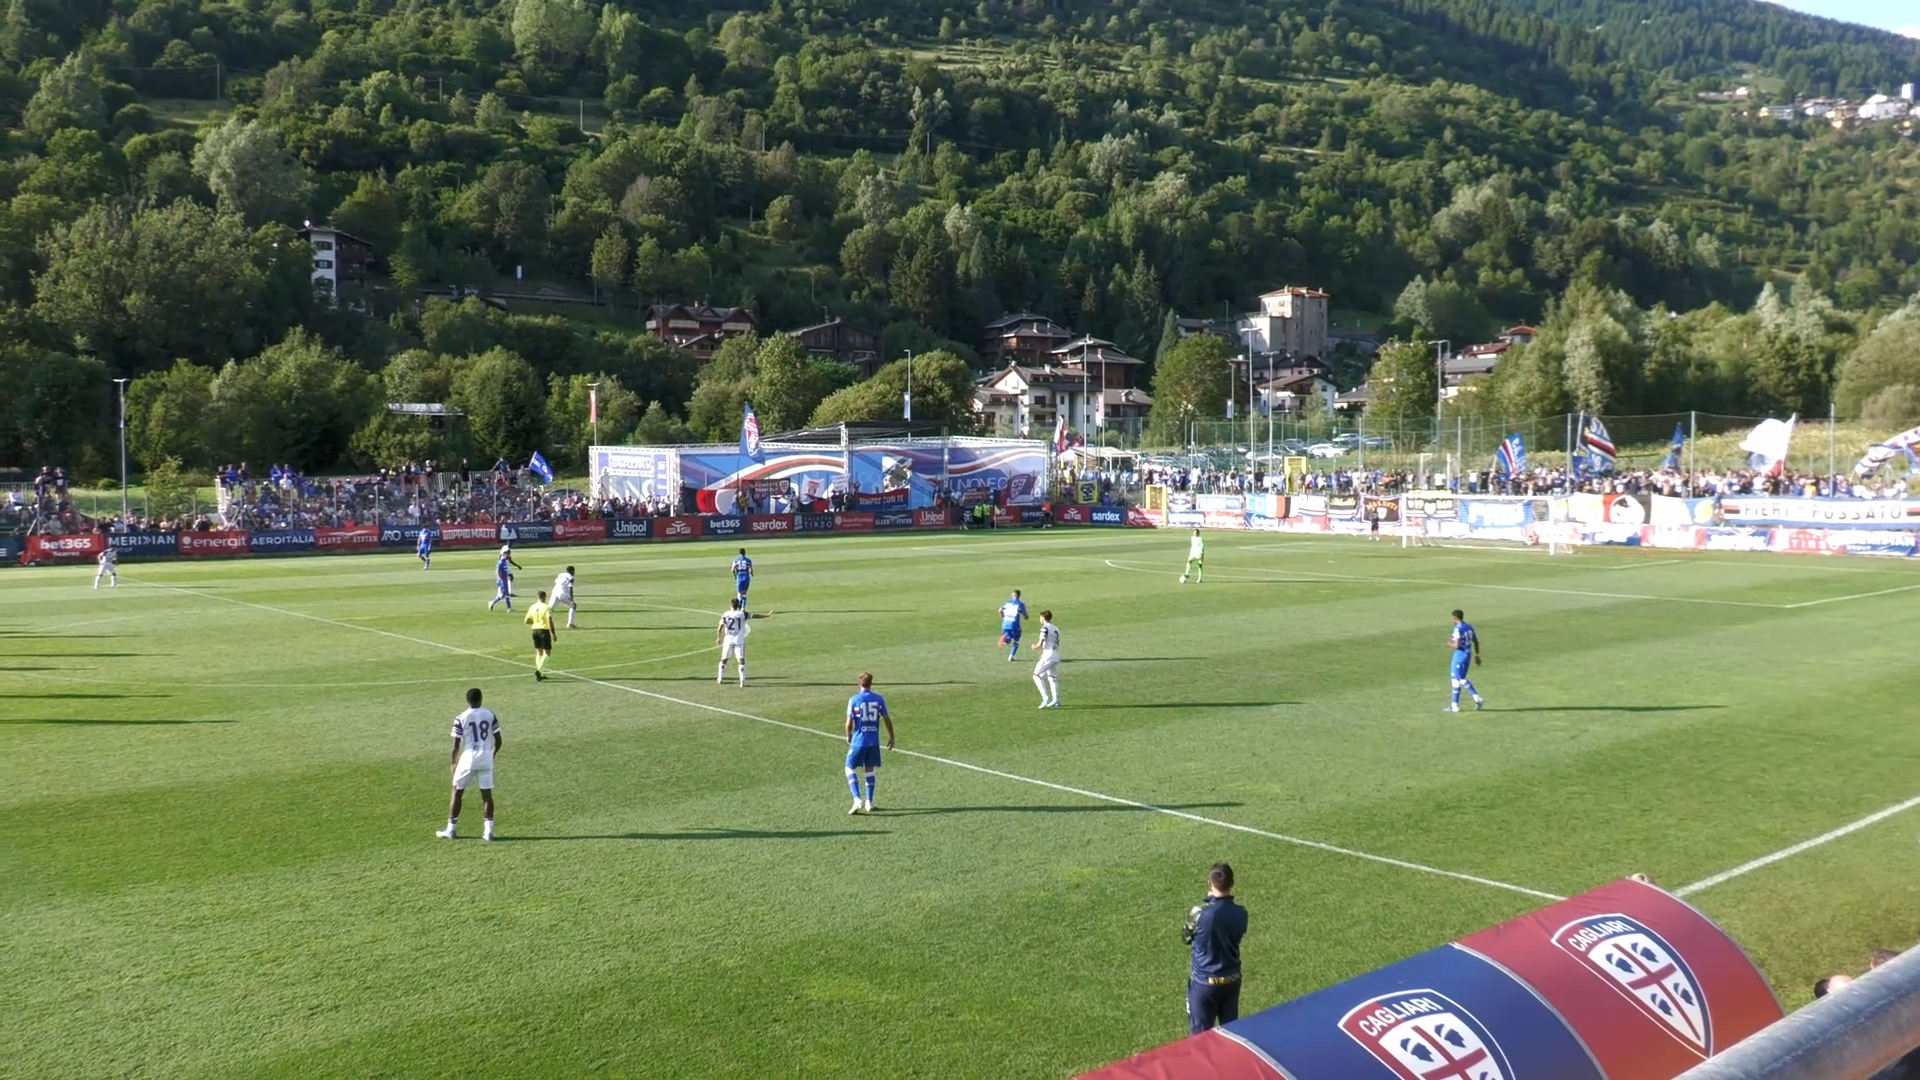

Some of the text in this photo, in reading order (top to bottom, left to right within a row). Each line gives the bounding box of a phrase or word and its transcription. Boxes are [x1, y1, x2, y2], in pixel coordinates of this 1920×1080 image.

[859, 497, 882, 506] SEMPRE
[920, 511, 945, 523] Unipol
[1092, 511, 1121, 522] sardex
[615, 520, 647, 537] Unipol
[710, 519, 741, 529] bet365
[752, 519, 788, 531] sardex
[804, 521, 833, 529] TIRSO
[251, 535, 315, 546] AEROITALIA
[443, 528, 497, 541] DOPPIO MALTO
[40, 537, 92, 550] bet365
[193, 535, 247, 549] energit
[727, 616, 741, 631] 21
[860, 701, 879, 722] 15
[468, 720, 490, 742] 18
[1568, 919, 1636, 952] CAGLIARI
[1358, 997, 1444, 1037] CAGLIARI
